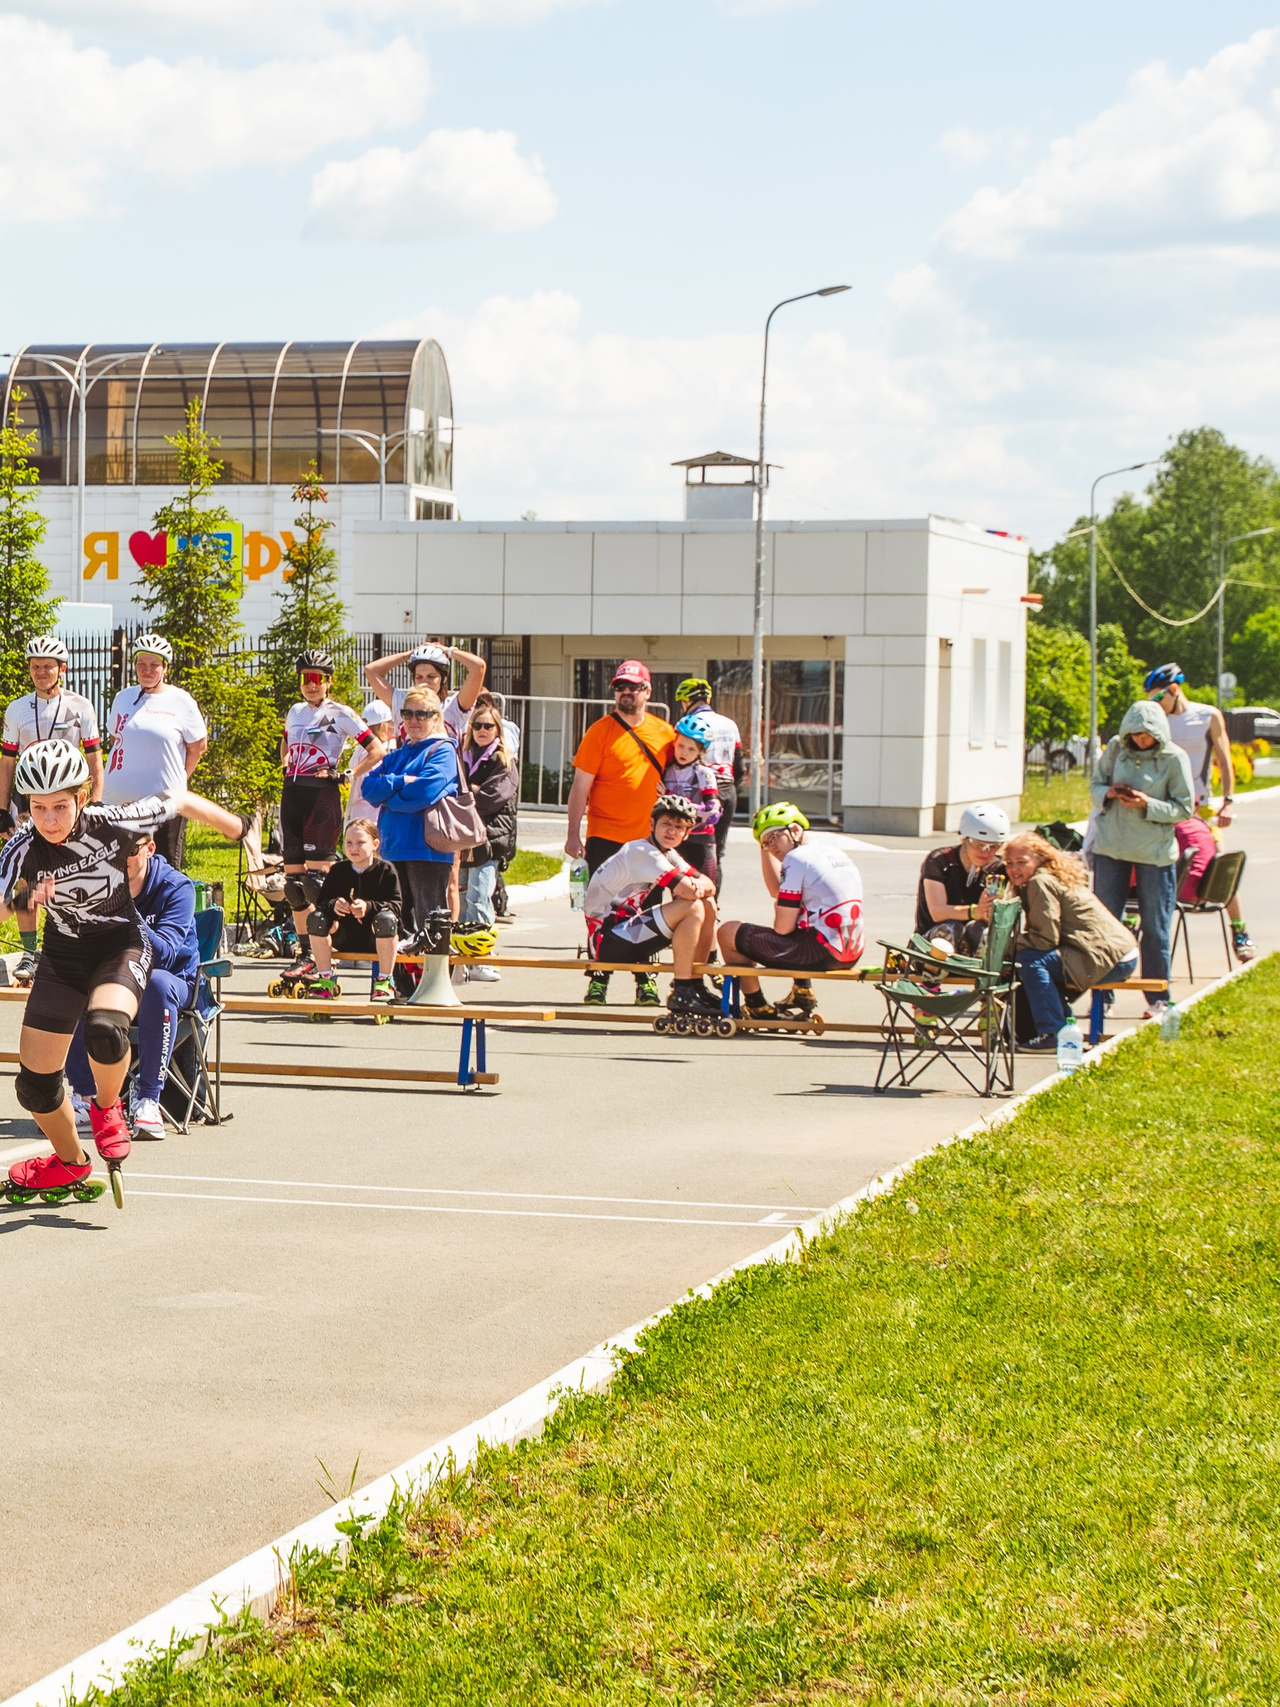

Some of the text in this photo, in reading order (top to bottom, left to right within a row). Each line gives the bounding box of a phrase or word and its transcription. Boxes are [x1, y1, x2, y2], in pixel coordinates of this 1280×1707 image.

[83, 530, 322, 581] Я ФУ
[37, 839, 120, 882] FLYING EAGLE
[157, 1021, 171, 1081] TOMMY SPORT
